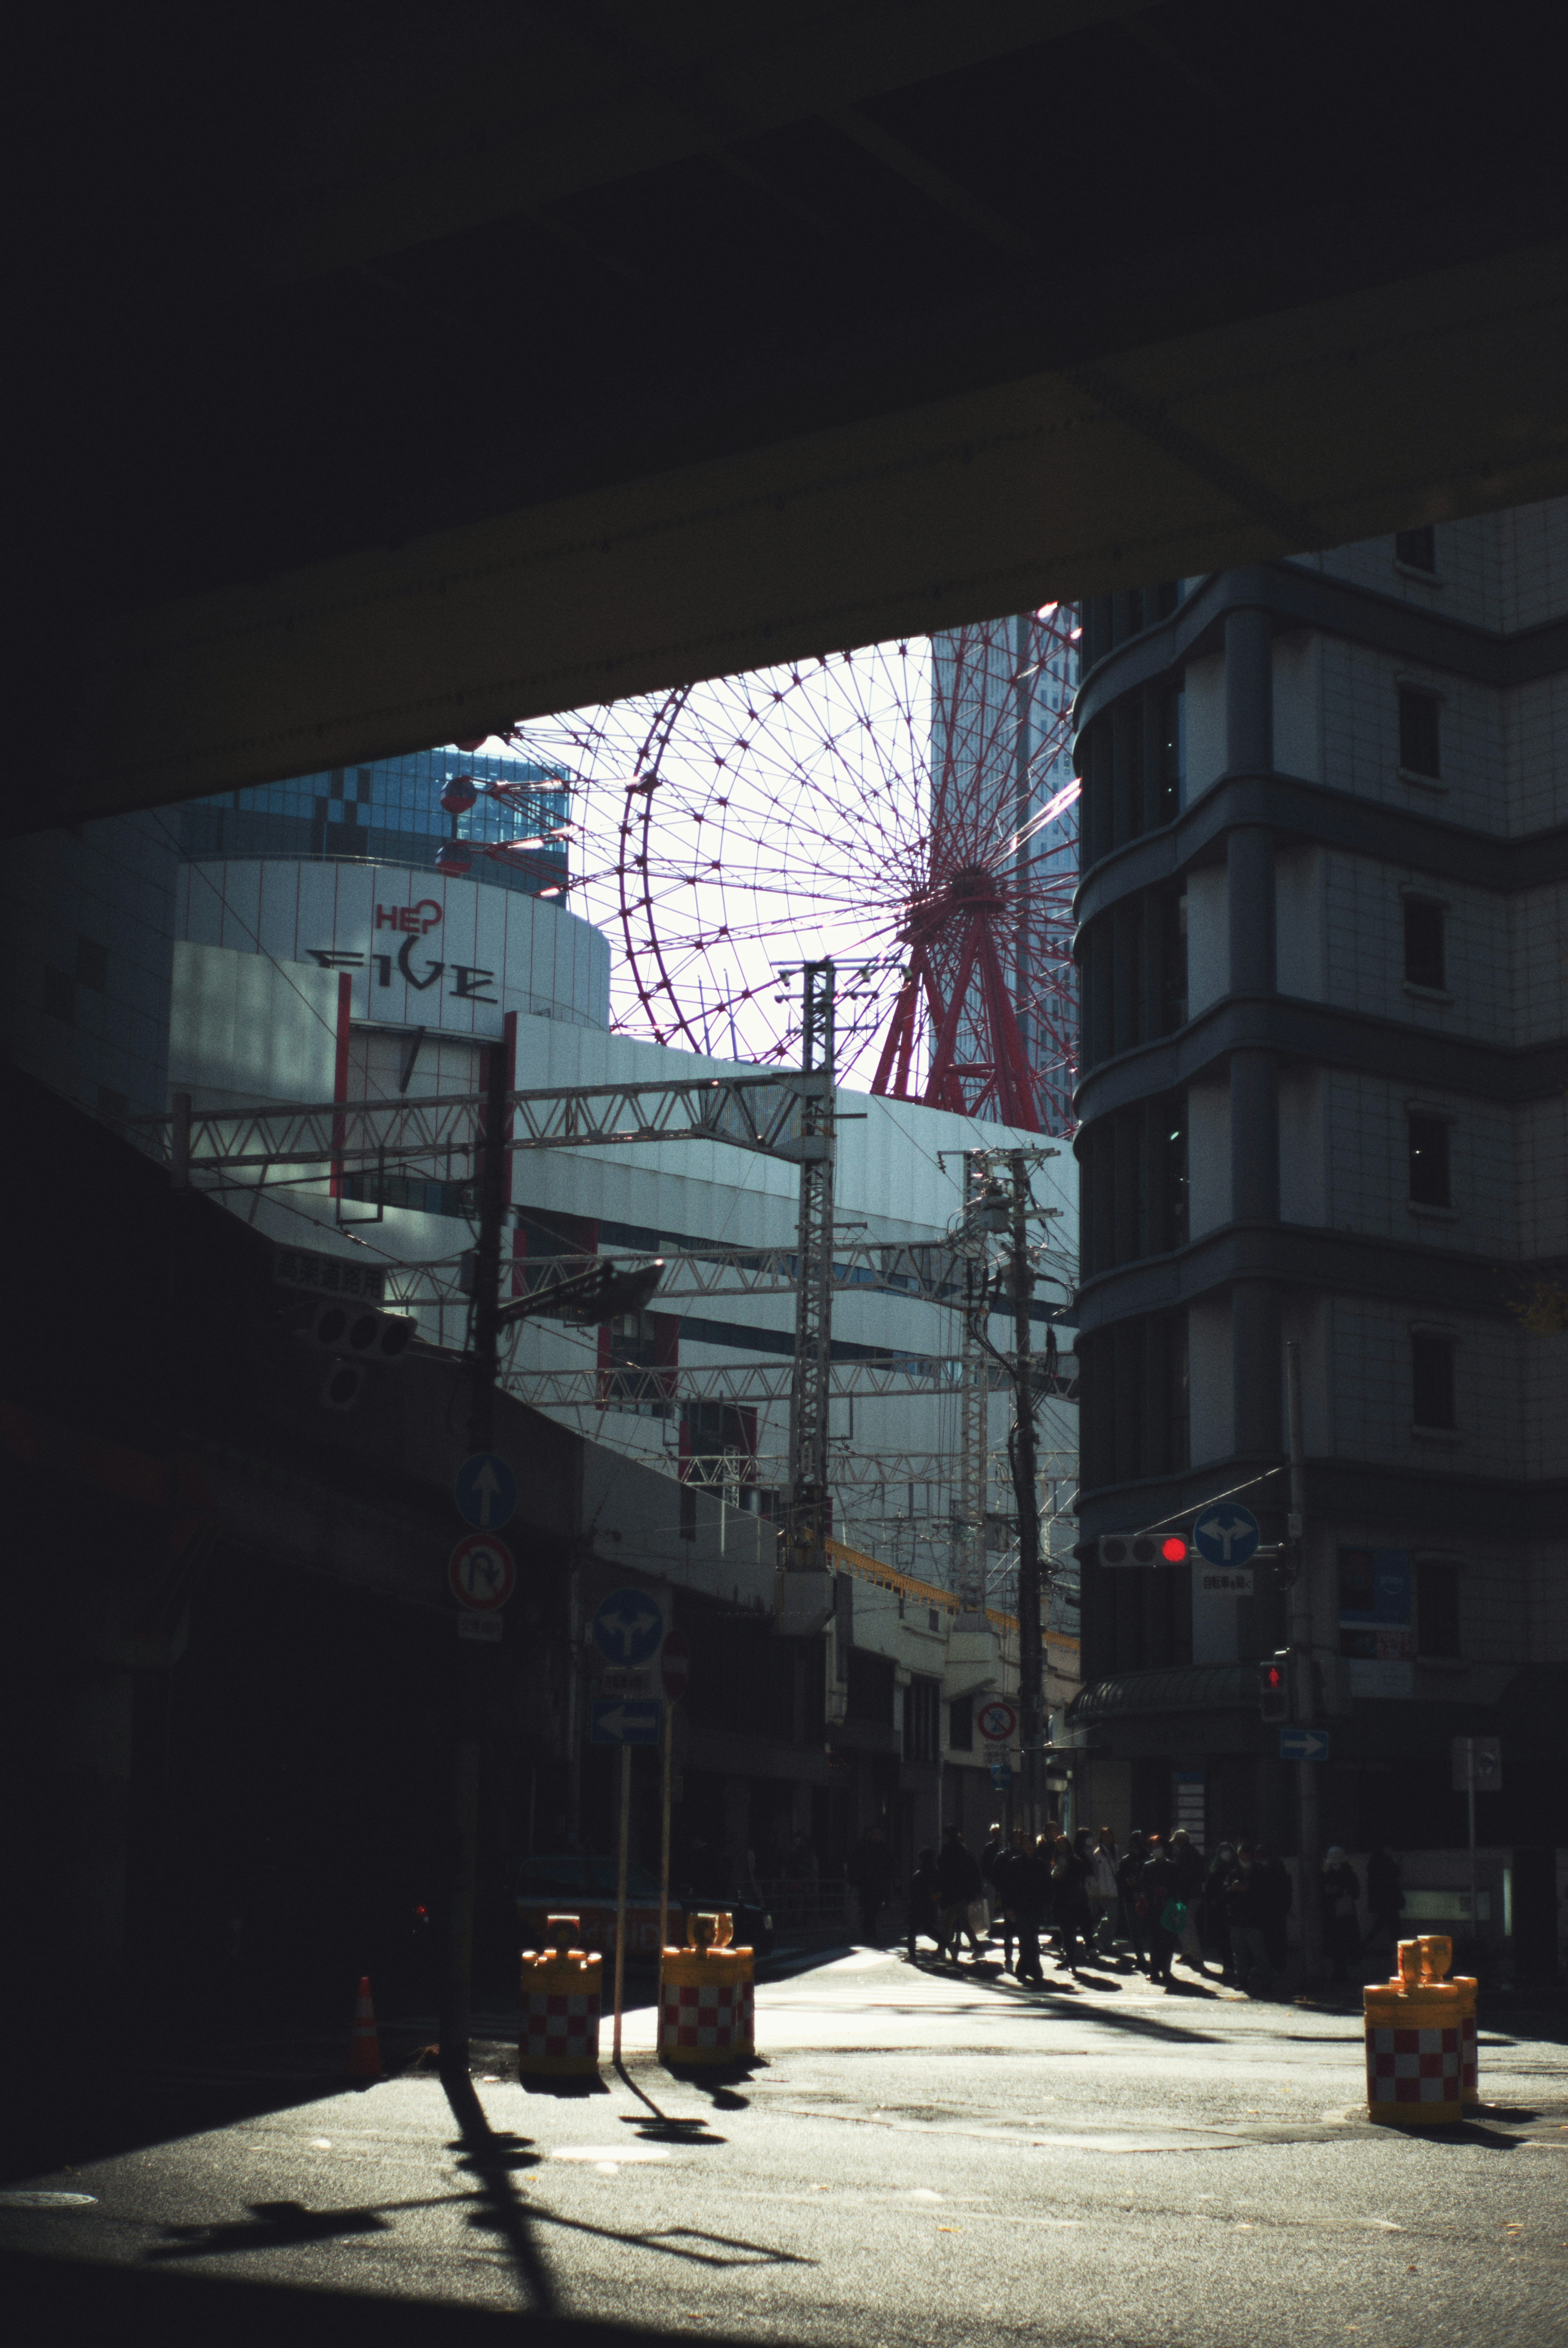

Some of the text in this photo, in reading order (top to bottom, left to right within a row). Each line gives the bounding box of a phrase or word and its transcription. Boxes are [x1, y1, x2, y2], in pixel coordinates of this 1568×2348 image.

[376, 899, 442, 934] HEP
[306, 934, 498, 1004] FIVE
[278, 1249, 382, 1300] 高架道路用
[1203, 1576, 1252, 1589] 自転車を除く
